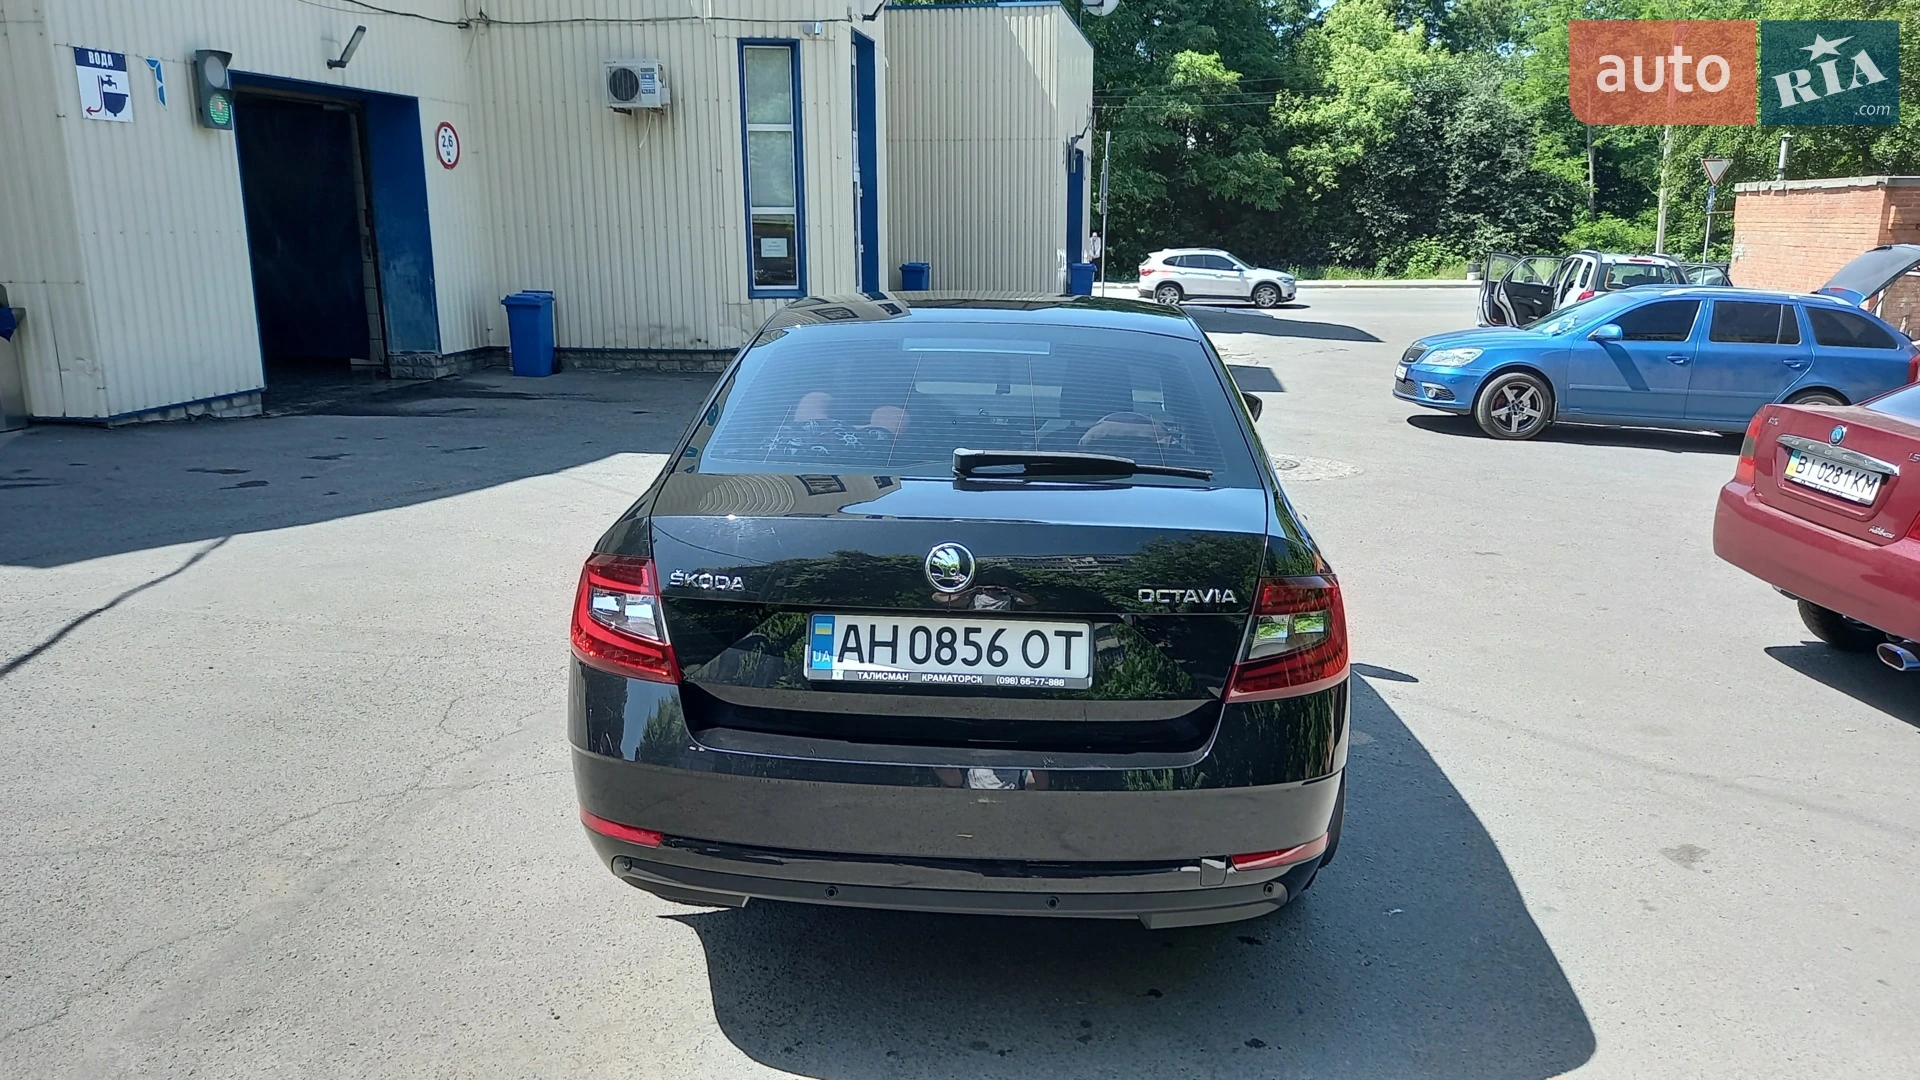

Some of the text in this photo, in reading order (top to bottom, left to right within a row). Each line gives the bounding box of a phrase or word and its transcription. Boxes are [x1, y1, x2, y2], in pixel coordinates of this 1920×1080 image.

[88, 51, 114, 68] ВОДА
[1795, 456, 1816, 477] BI
[1817, 462, 1850, 487] 0281
[1850, 471, 1879, 496] KM
[669, 569, 746, 592] ŠKODA
[1137, 588, 1239, 604] OCTAVIA
[812, 650, 831, 662] UA
[837, 624, 1084, 671] AH 0856 OT
[857, 671, 1066, 687] ТАЛИСМАН КРАМАТОРСК (098) 66-77-888
